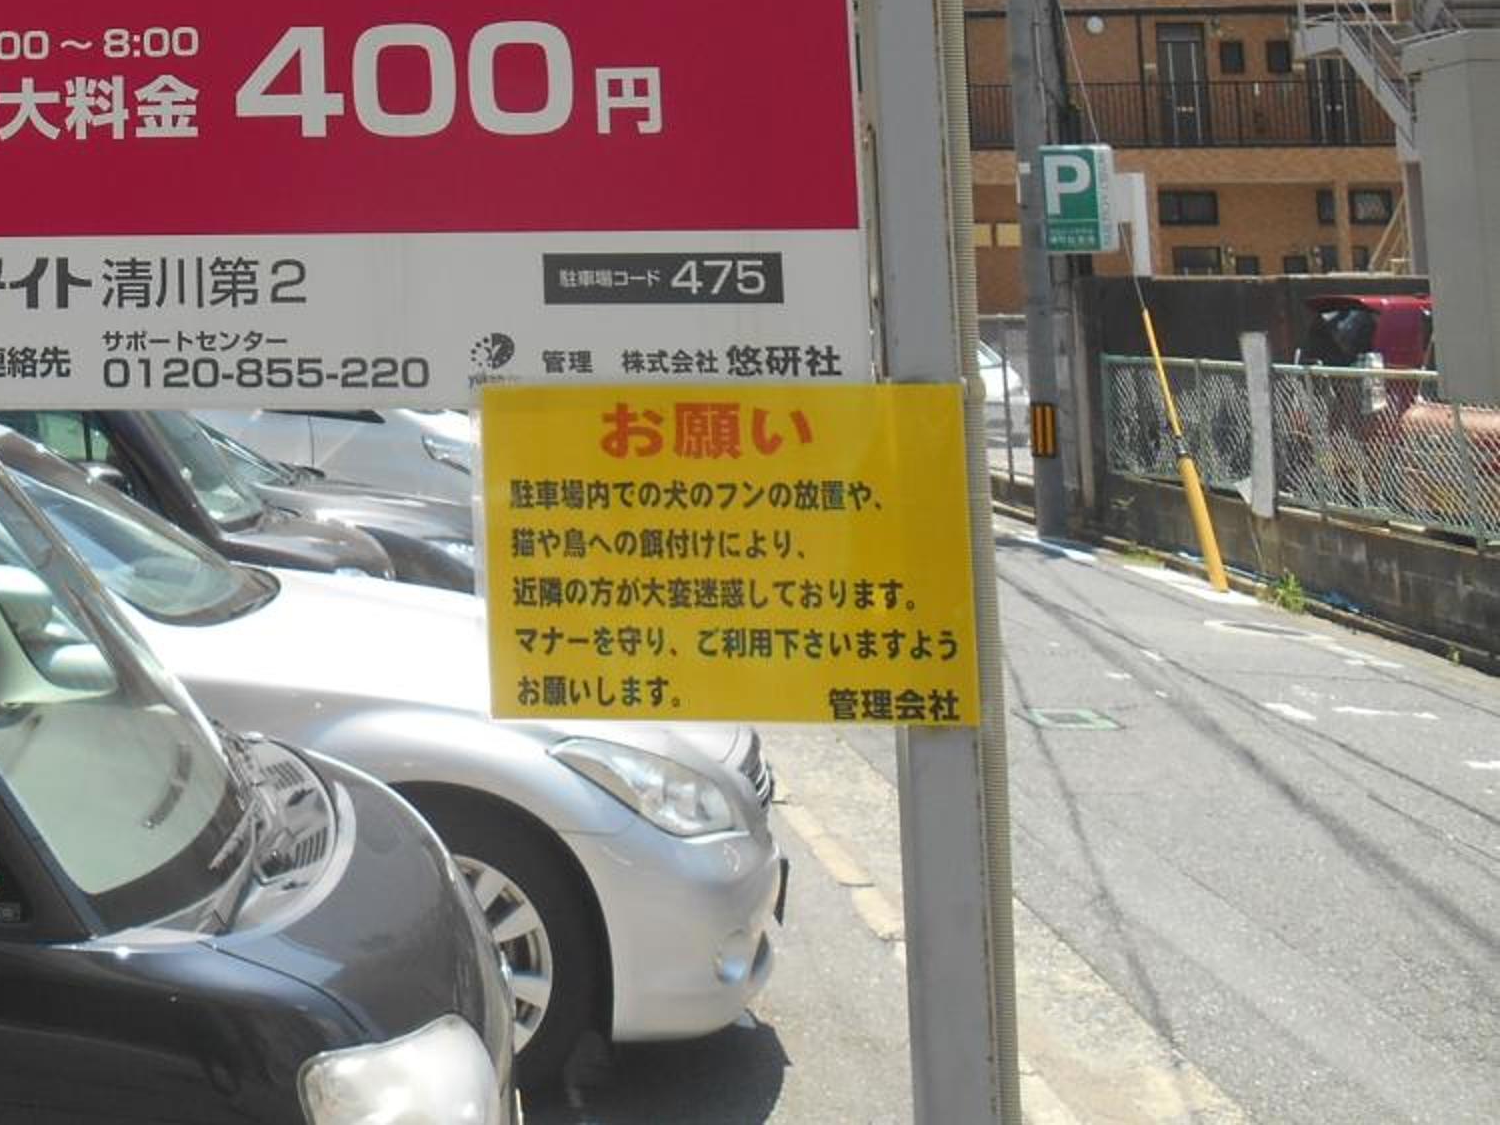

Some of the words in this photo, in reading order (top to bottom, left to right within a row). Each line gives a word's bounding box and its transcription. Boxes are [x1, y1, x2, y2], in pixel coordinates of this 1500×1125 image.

[1044, 154, 1092, 215] P
[670, 259, 767, 295] 475
[102, 329, 288, 353] サポートセンター
[102, 356, 431, 390] 0120-855-220
[542, 350, 593, 375] 管理
[601, 401, 814, 460] お願い
[509, 479, 884, 512] 駐車場内での犬のフンの放置や、
[511, 527, 806, 560] 猫や鳥への餌付けにより、
[513, 577, 917, 612] 近隣の方が大変迷惑しております。
[518, 675, 682, 708] お願いします。
[828, 688, 960, 722] 管理会社
